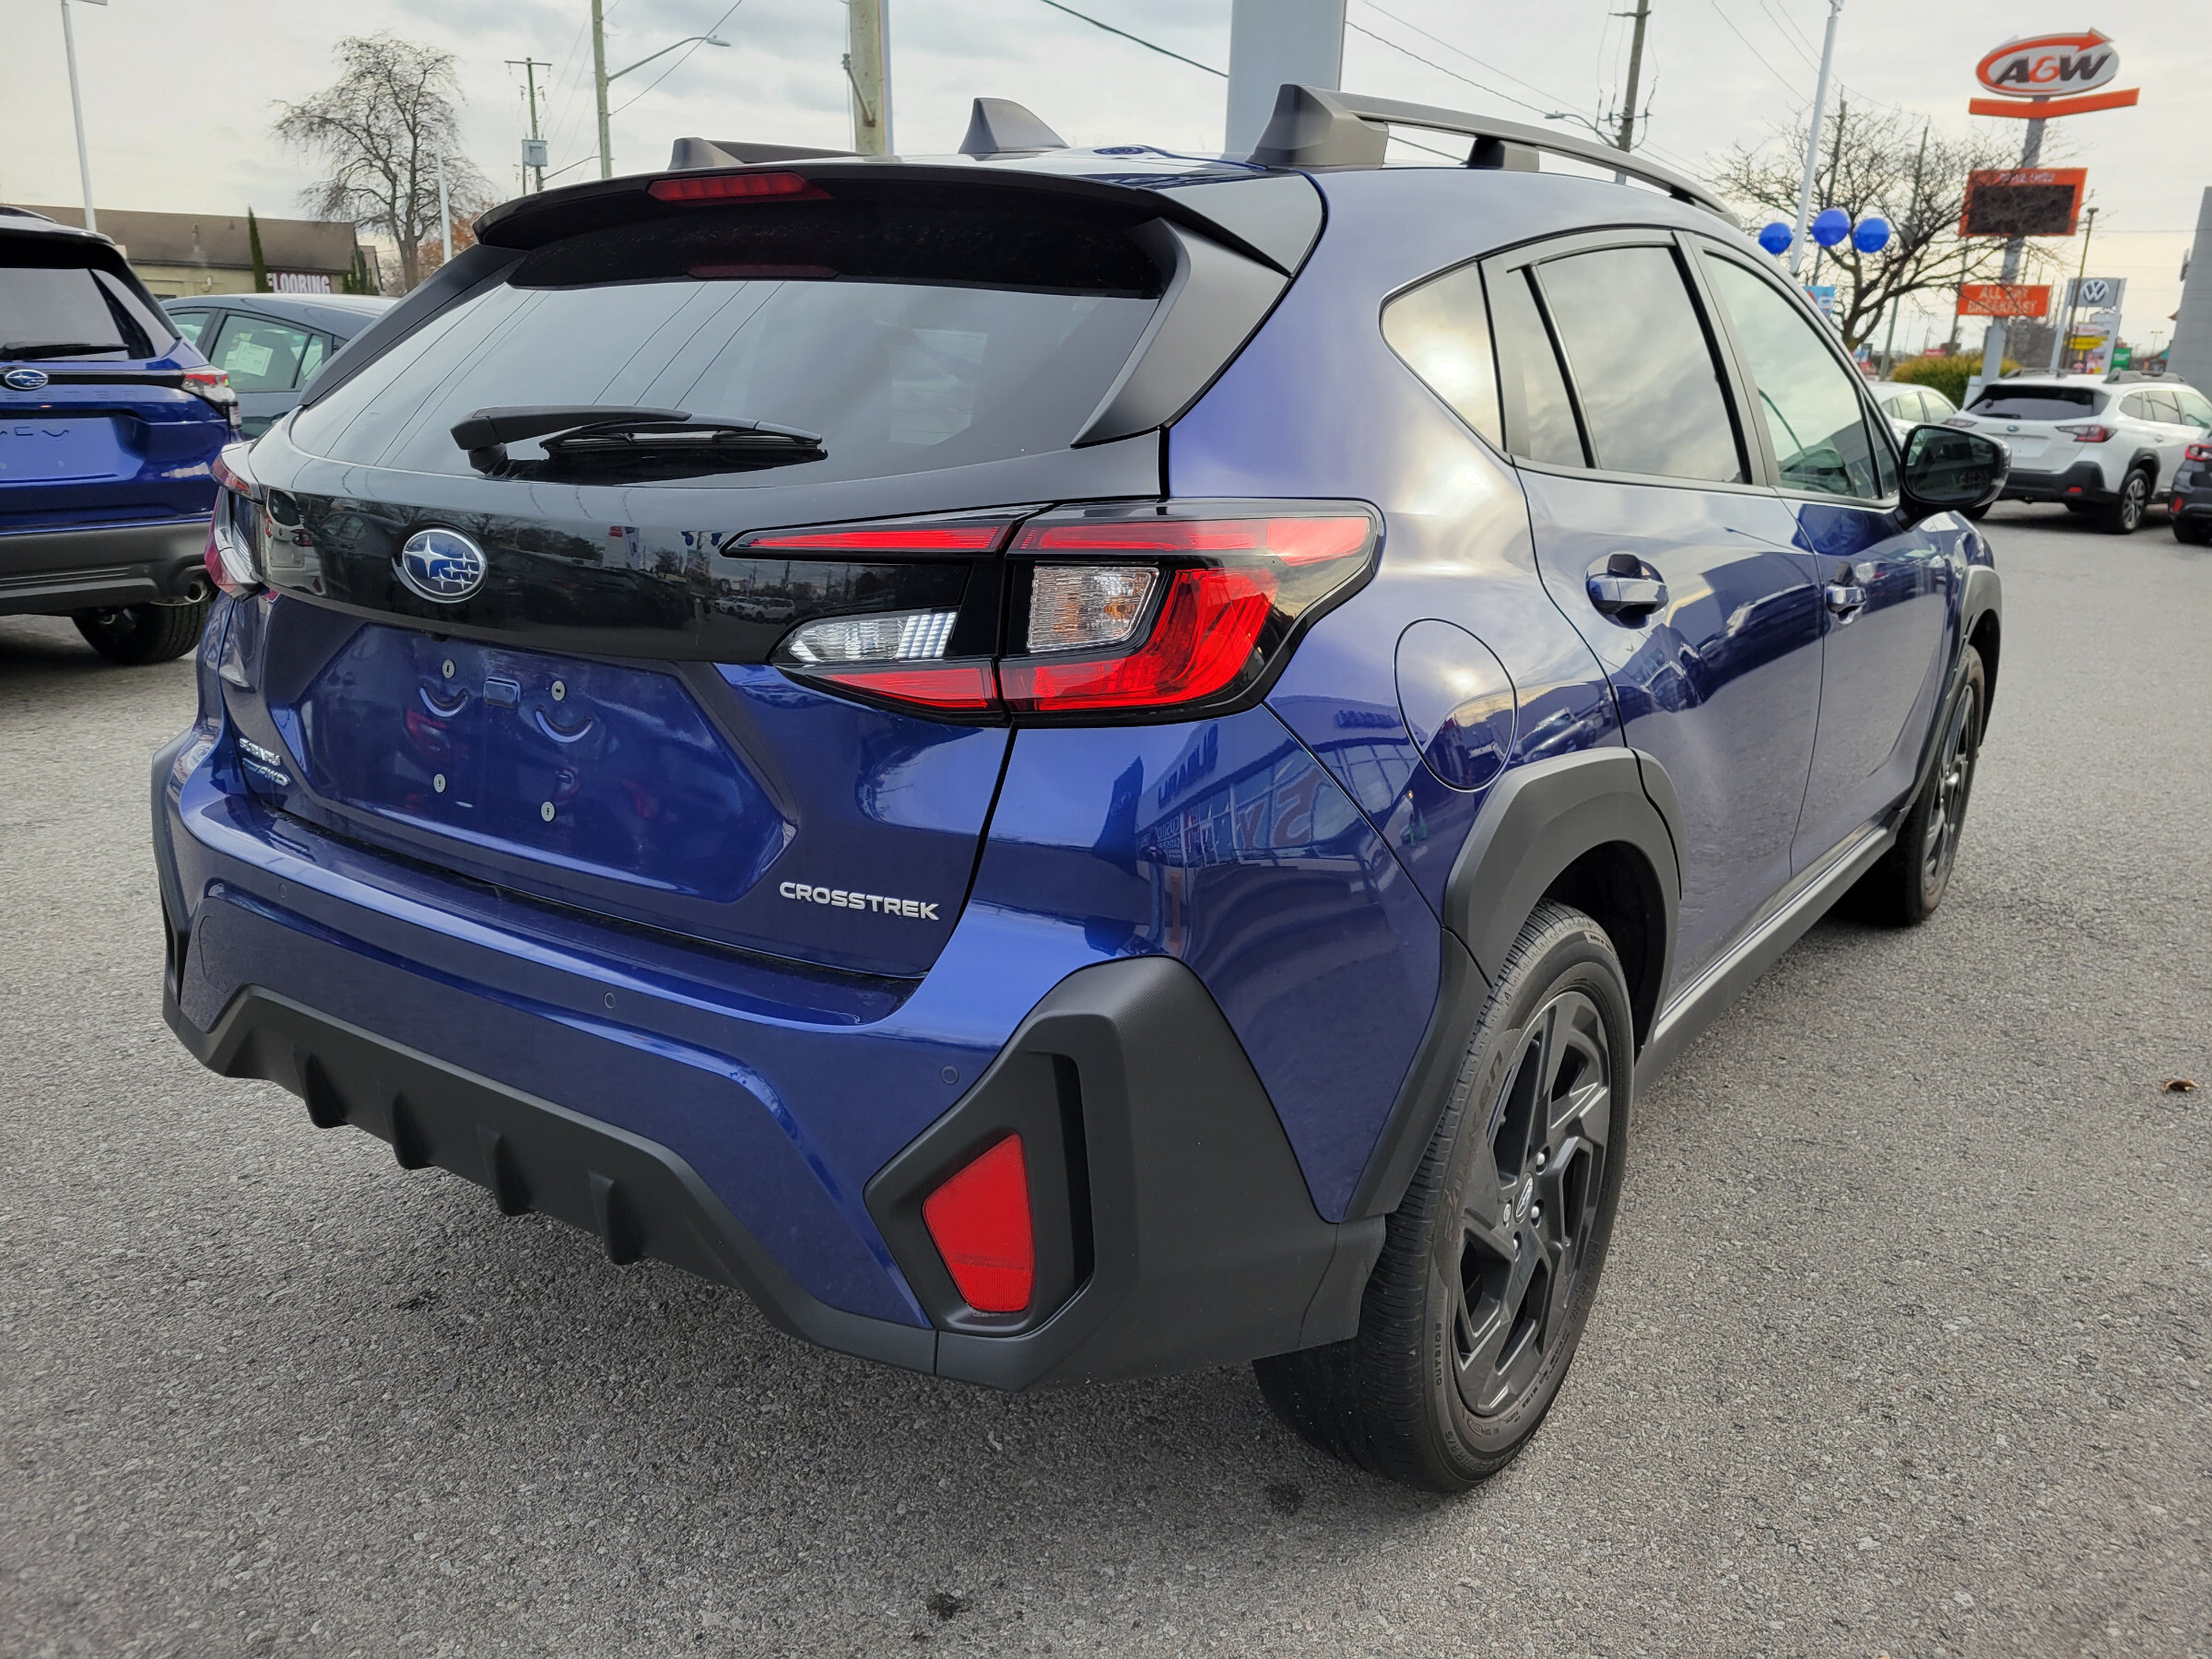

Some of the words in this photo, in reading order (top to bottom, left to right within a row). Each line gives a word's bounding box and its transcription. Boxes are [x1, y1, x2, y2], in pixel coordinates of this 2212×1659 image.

[1991, 52, 2112, 85] A&W
[266, 273, 331, 293] FLOORING
[780, 881, 939, 920] CROSSTREK
[1434, 1322, 1442, 1386] OUTSIDE
